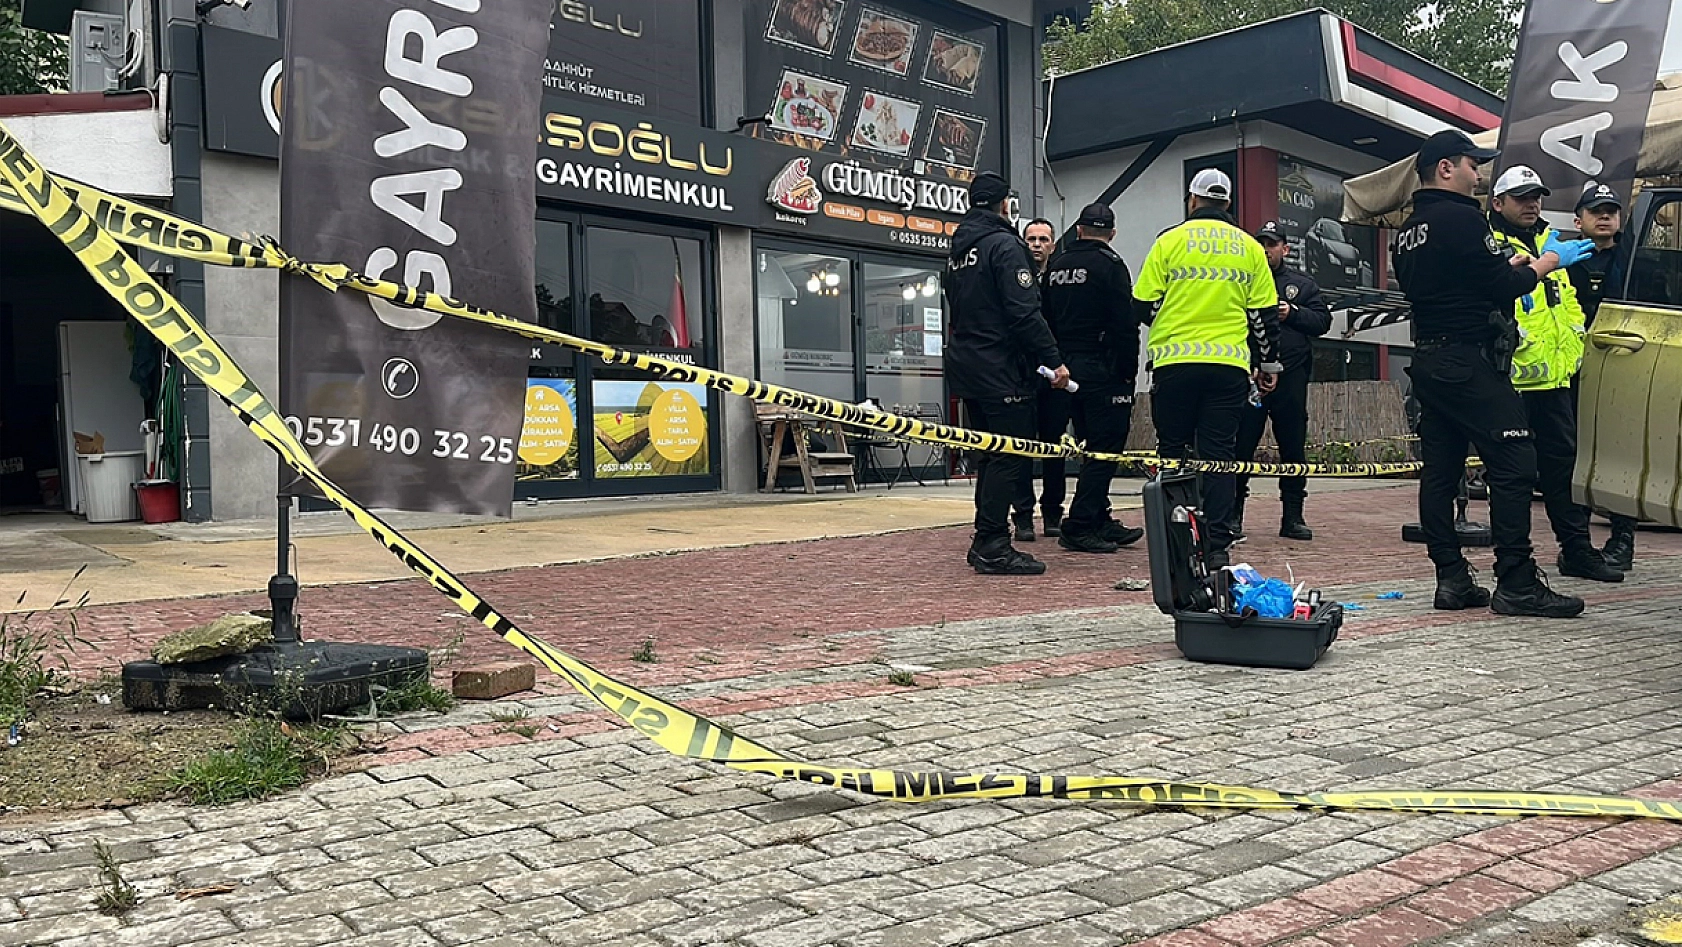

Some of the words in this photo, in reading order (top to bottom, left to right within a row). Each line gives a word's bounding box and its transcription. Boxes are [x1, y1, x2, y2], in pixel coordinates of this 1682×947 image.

[579, 81, 646, 107] HİZMETLERİ
[361, 0, 481, 331] GAYR
[535, 158, 734, 212] GAYRİMENKUL
[824, 159, 916, 211] GÜMÜŞ
[775, 212, 808, 226] kokoreç
[899, 232, 920, 244] 0535
[921, 235, 936, 248] 235
[285, 416, 361, 447] 0531
[369, 423, 421, 455] 490
[432, 430, 469, 459] 32
[480, 435, 514, 464] 25
